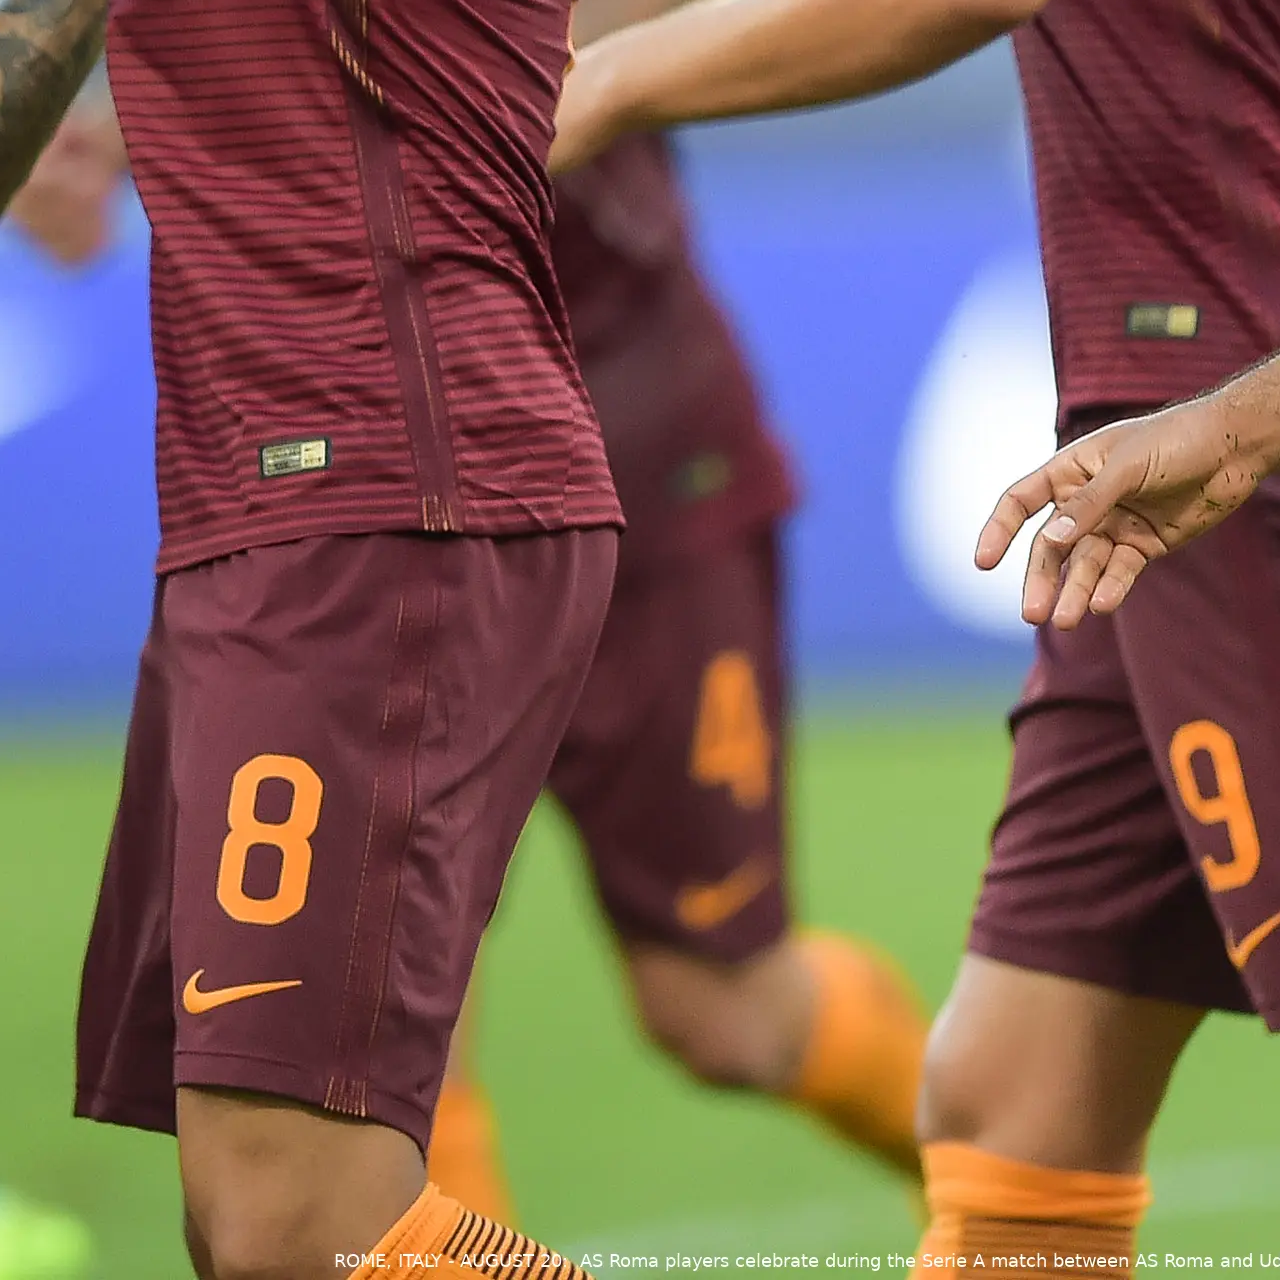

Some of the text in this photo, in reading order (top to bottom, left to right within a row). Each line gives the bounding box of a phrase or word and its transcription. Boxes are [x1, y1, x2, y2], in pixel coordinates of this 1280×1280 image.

[689, 650, 772, 810] 4
[1168, 719, 1261, 893] 9
[215, 753, 324, 926] 8
